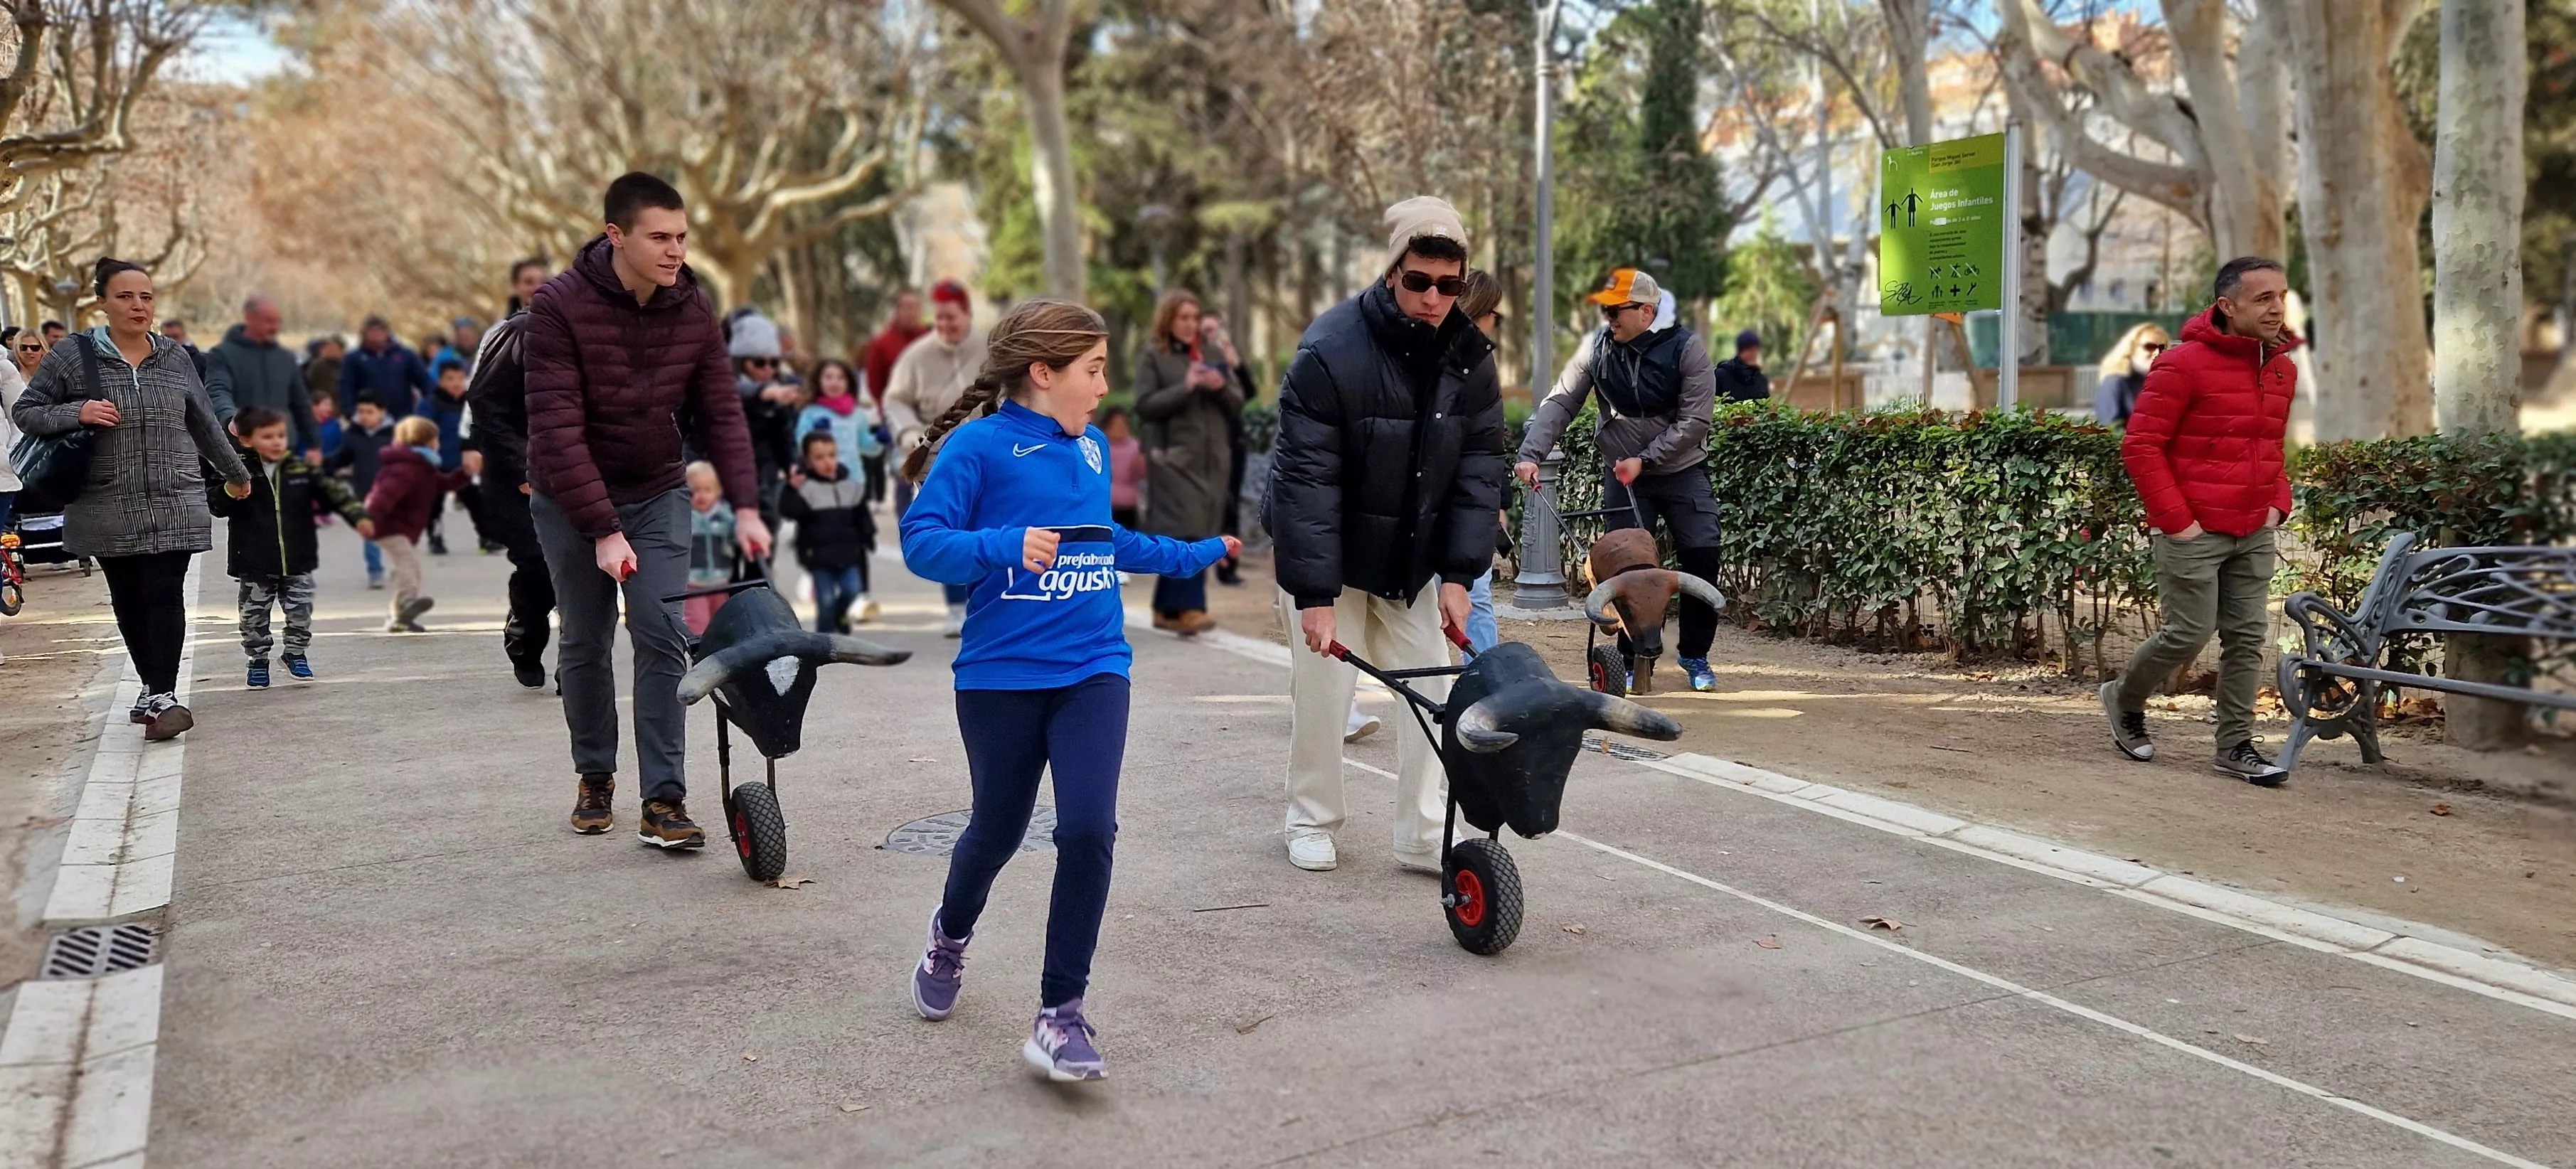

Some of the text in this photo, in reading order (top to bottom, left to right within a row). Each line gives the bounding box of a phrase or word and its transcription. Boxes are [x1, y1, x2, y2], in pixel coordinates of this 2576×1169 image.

[1930, 188, 1959, 200] Área de
[1930, 196, 1994, 211] Juegos Infantiles
